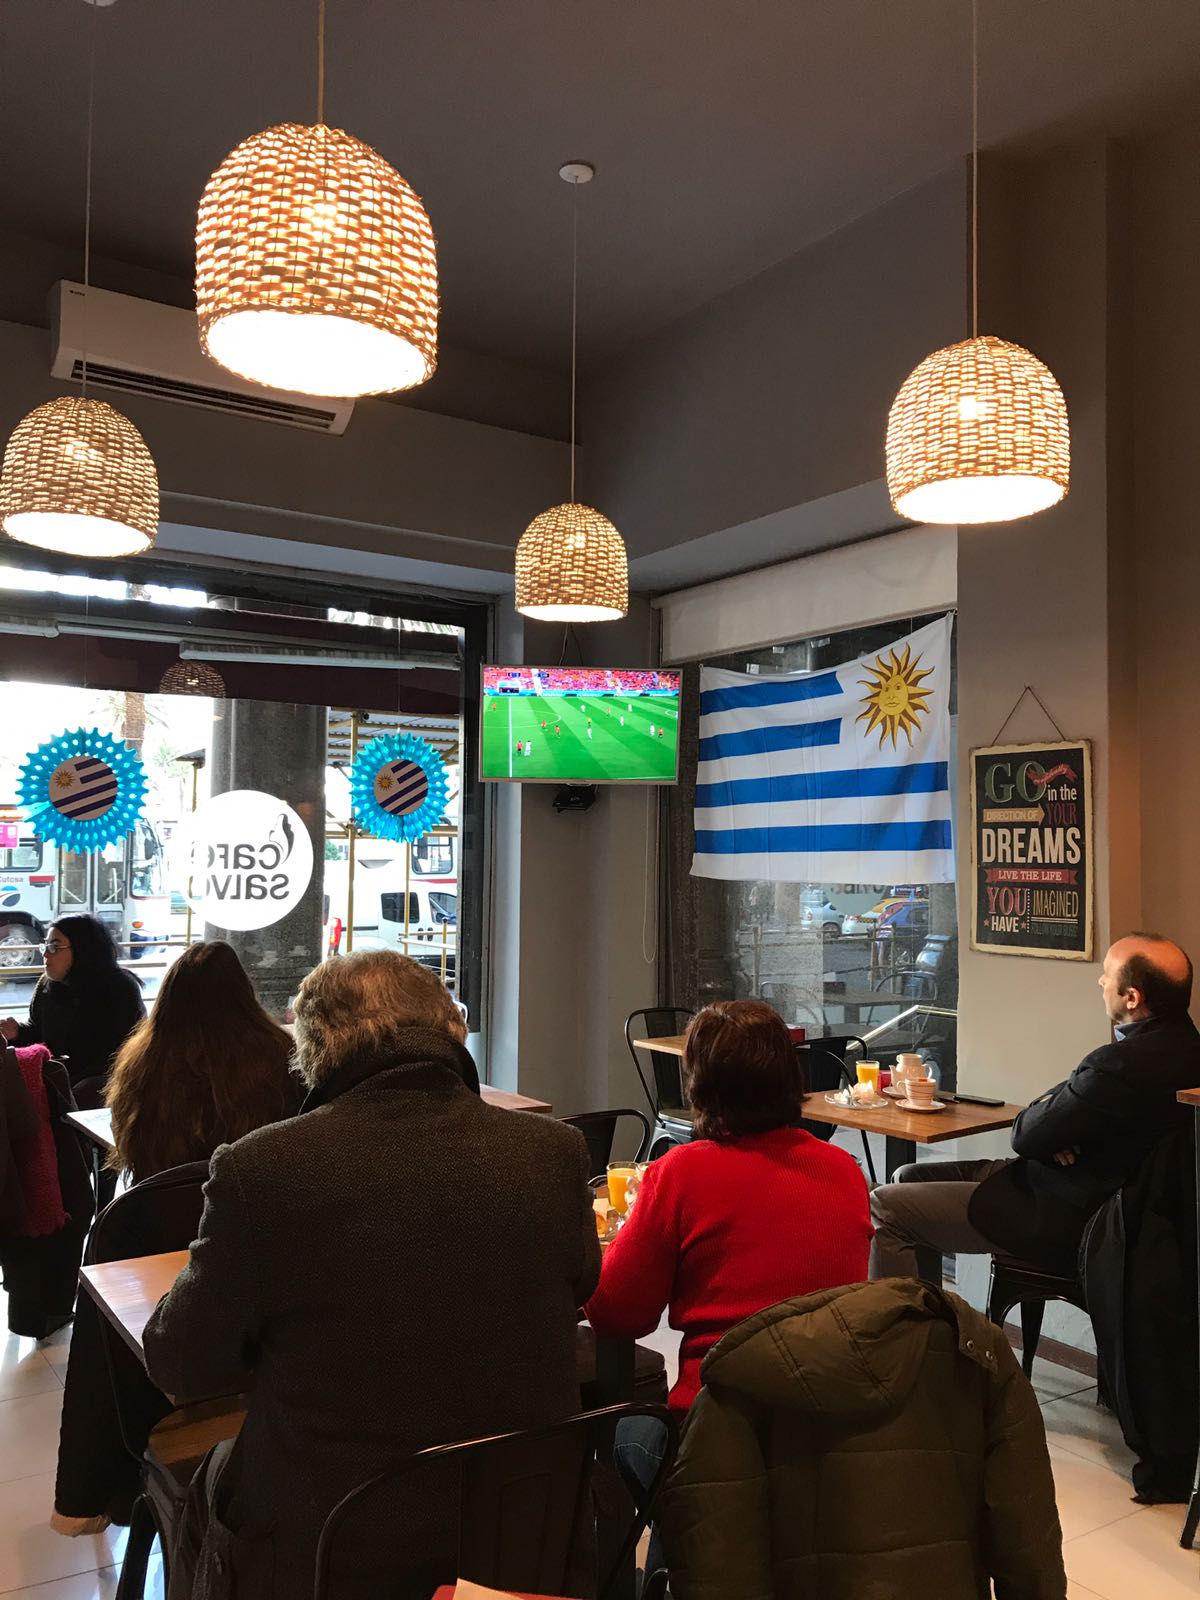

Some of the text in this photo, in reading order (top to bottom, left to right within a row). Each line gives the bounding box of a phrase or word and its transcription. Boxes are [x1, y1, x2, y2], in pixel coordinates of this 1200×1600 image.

[985, 761, 1047, 803] GO
[1047, 783, 1077, 801] in the
[986, 809, 1039, 821] DIRECTION OF
[1047, 802, 1077, 825] YOUR
[982, 827, 1081, 865] DREAMS
[998, 870, 1062, 881] LIVE THE LIFE
[986, 887, 1028, 916] YOU
[1033, 889, 1079, 918] IMAGINED
[991, 915, 1019, 933] HAVE
